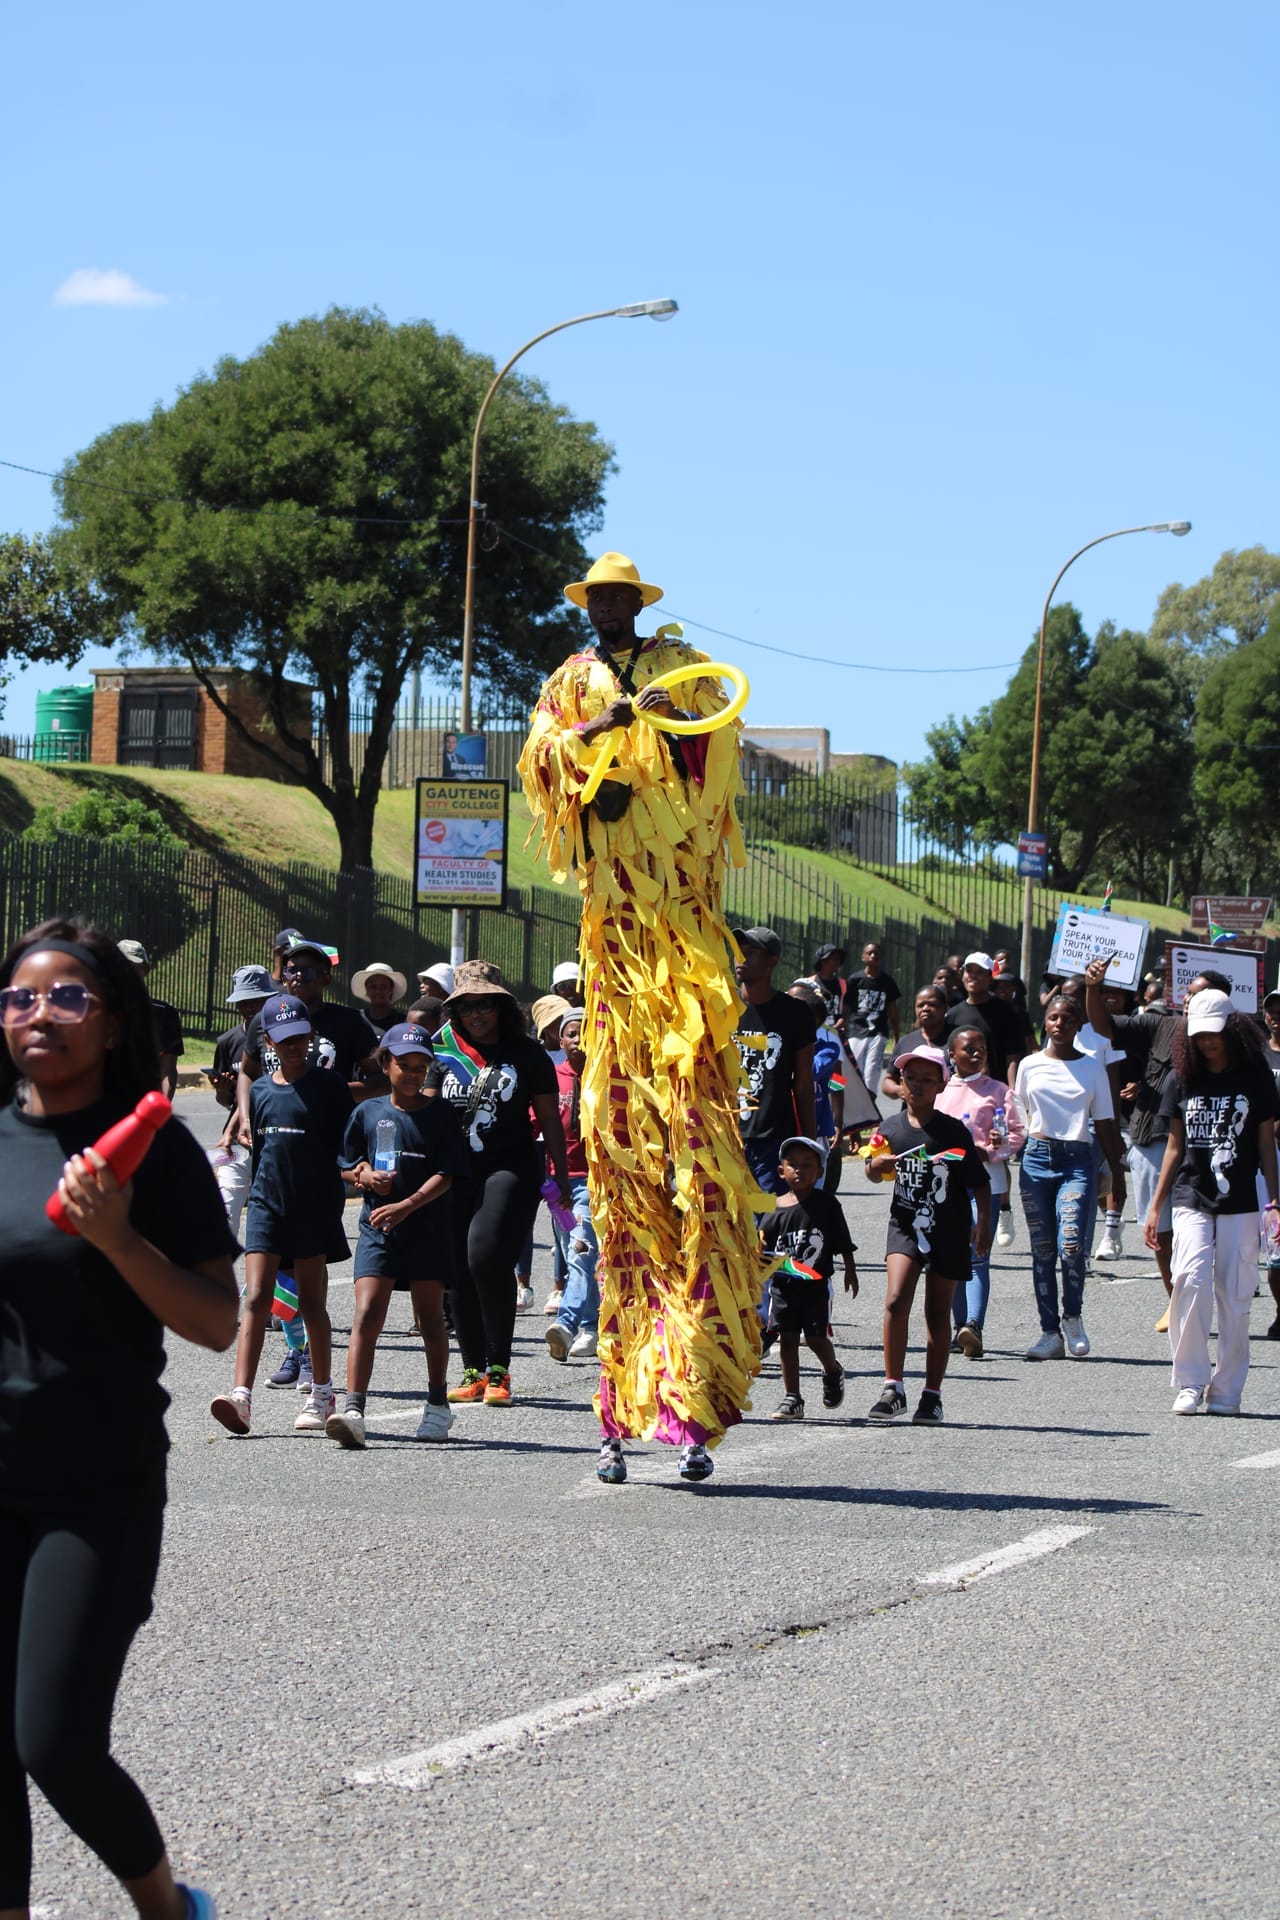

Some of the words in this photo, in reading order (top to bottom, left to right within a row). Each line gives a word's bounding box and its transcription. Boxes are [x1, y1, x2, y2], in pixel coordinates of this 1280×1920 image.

[426, 787, 500, 800] GAUTENG
[425, 800, 449, 809] CITY
[451, 800, 500, 810] COLLEGE
[432, 860, 475, 869] FACULTY
[477, 860, 490, 869] OF
[424, 870, 458, 879] HEALTH
[459, 870, 497, 880] STUDIES
[1065, 929, 1092, 943] SPEAK
[1094, 935, 1116, 948] YOUR
[1062, 948, 1084, 959] YOUR
[1085, 953, 1109, 962] STEE
[1235, 983, 1255, 995] KEY.
[275, 1010, 297, 1022] GBVF
[402, 1033, 424, 1043] GBVF
[1187, 1096, 1207, 1110] WE,
[1210, 1096, 1231, 1110] THE
[1185, 1110, 1225, 1124] PEOPLE
[1186, 1124, 1219, 1139] WALK
[904, 1157, 927, 1173] THE
[786, 1230, 807, 1247] THE
